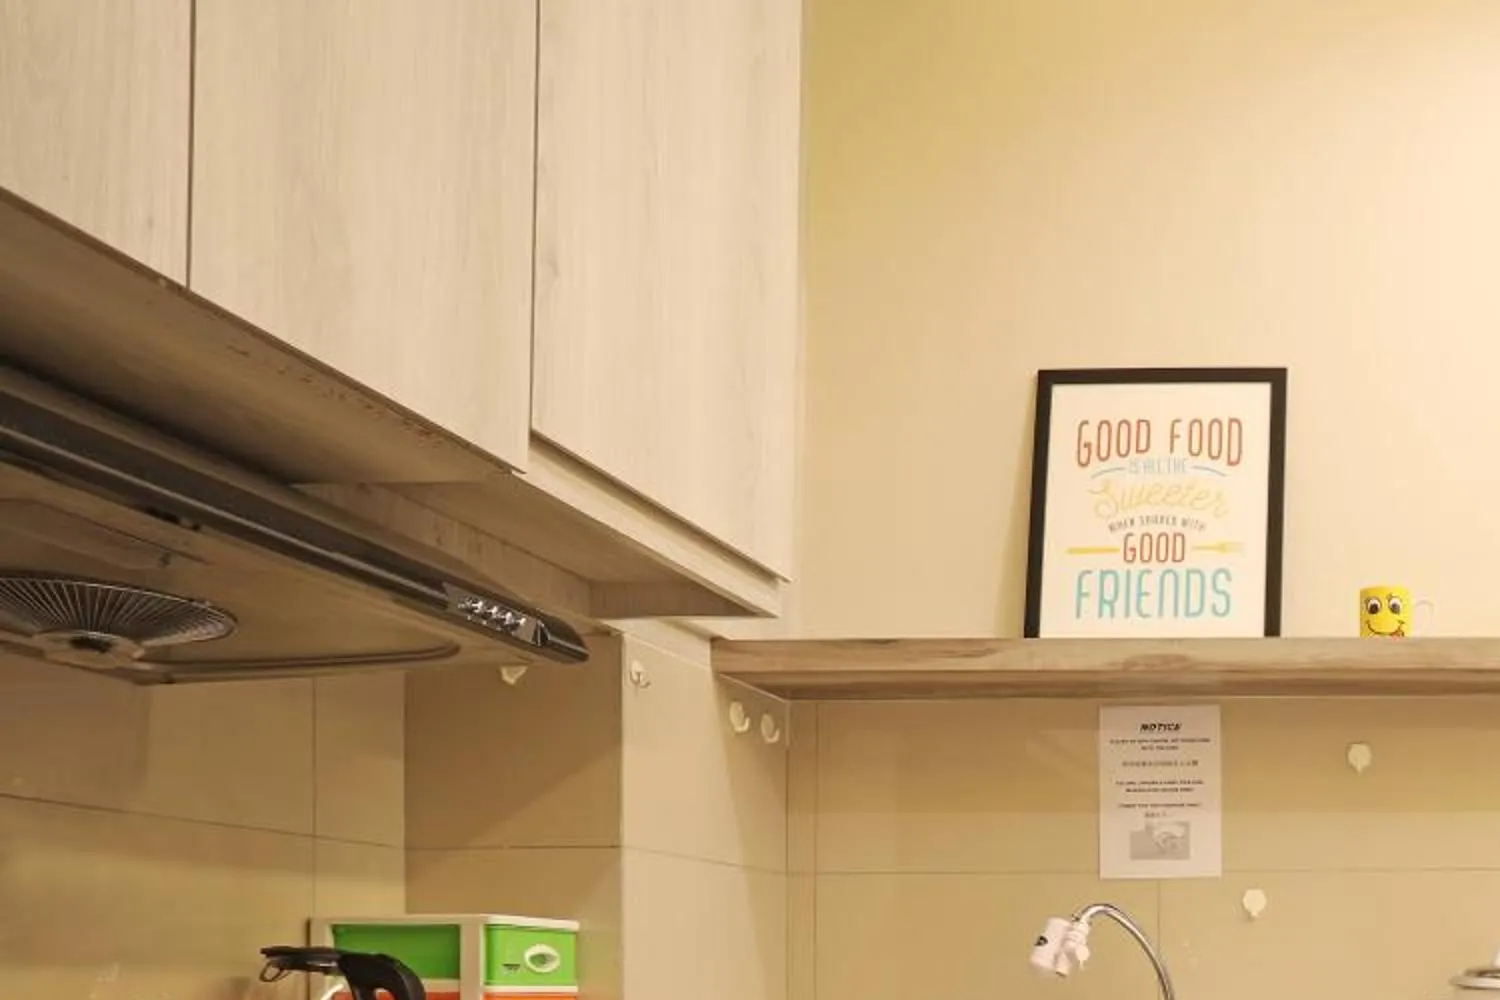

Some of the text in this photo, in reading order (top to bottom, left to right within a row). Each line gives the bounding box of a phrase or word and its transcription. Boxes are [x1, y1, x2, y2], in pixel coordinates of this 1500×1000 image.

[1077, 417, 1243, 467] GOOD FOOD
[1087, 479, 1229, 519] Sweeter
[1123, 532, 1186, 563] GOOD
[1075, 568, 1232, 619] FRIENDS
